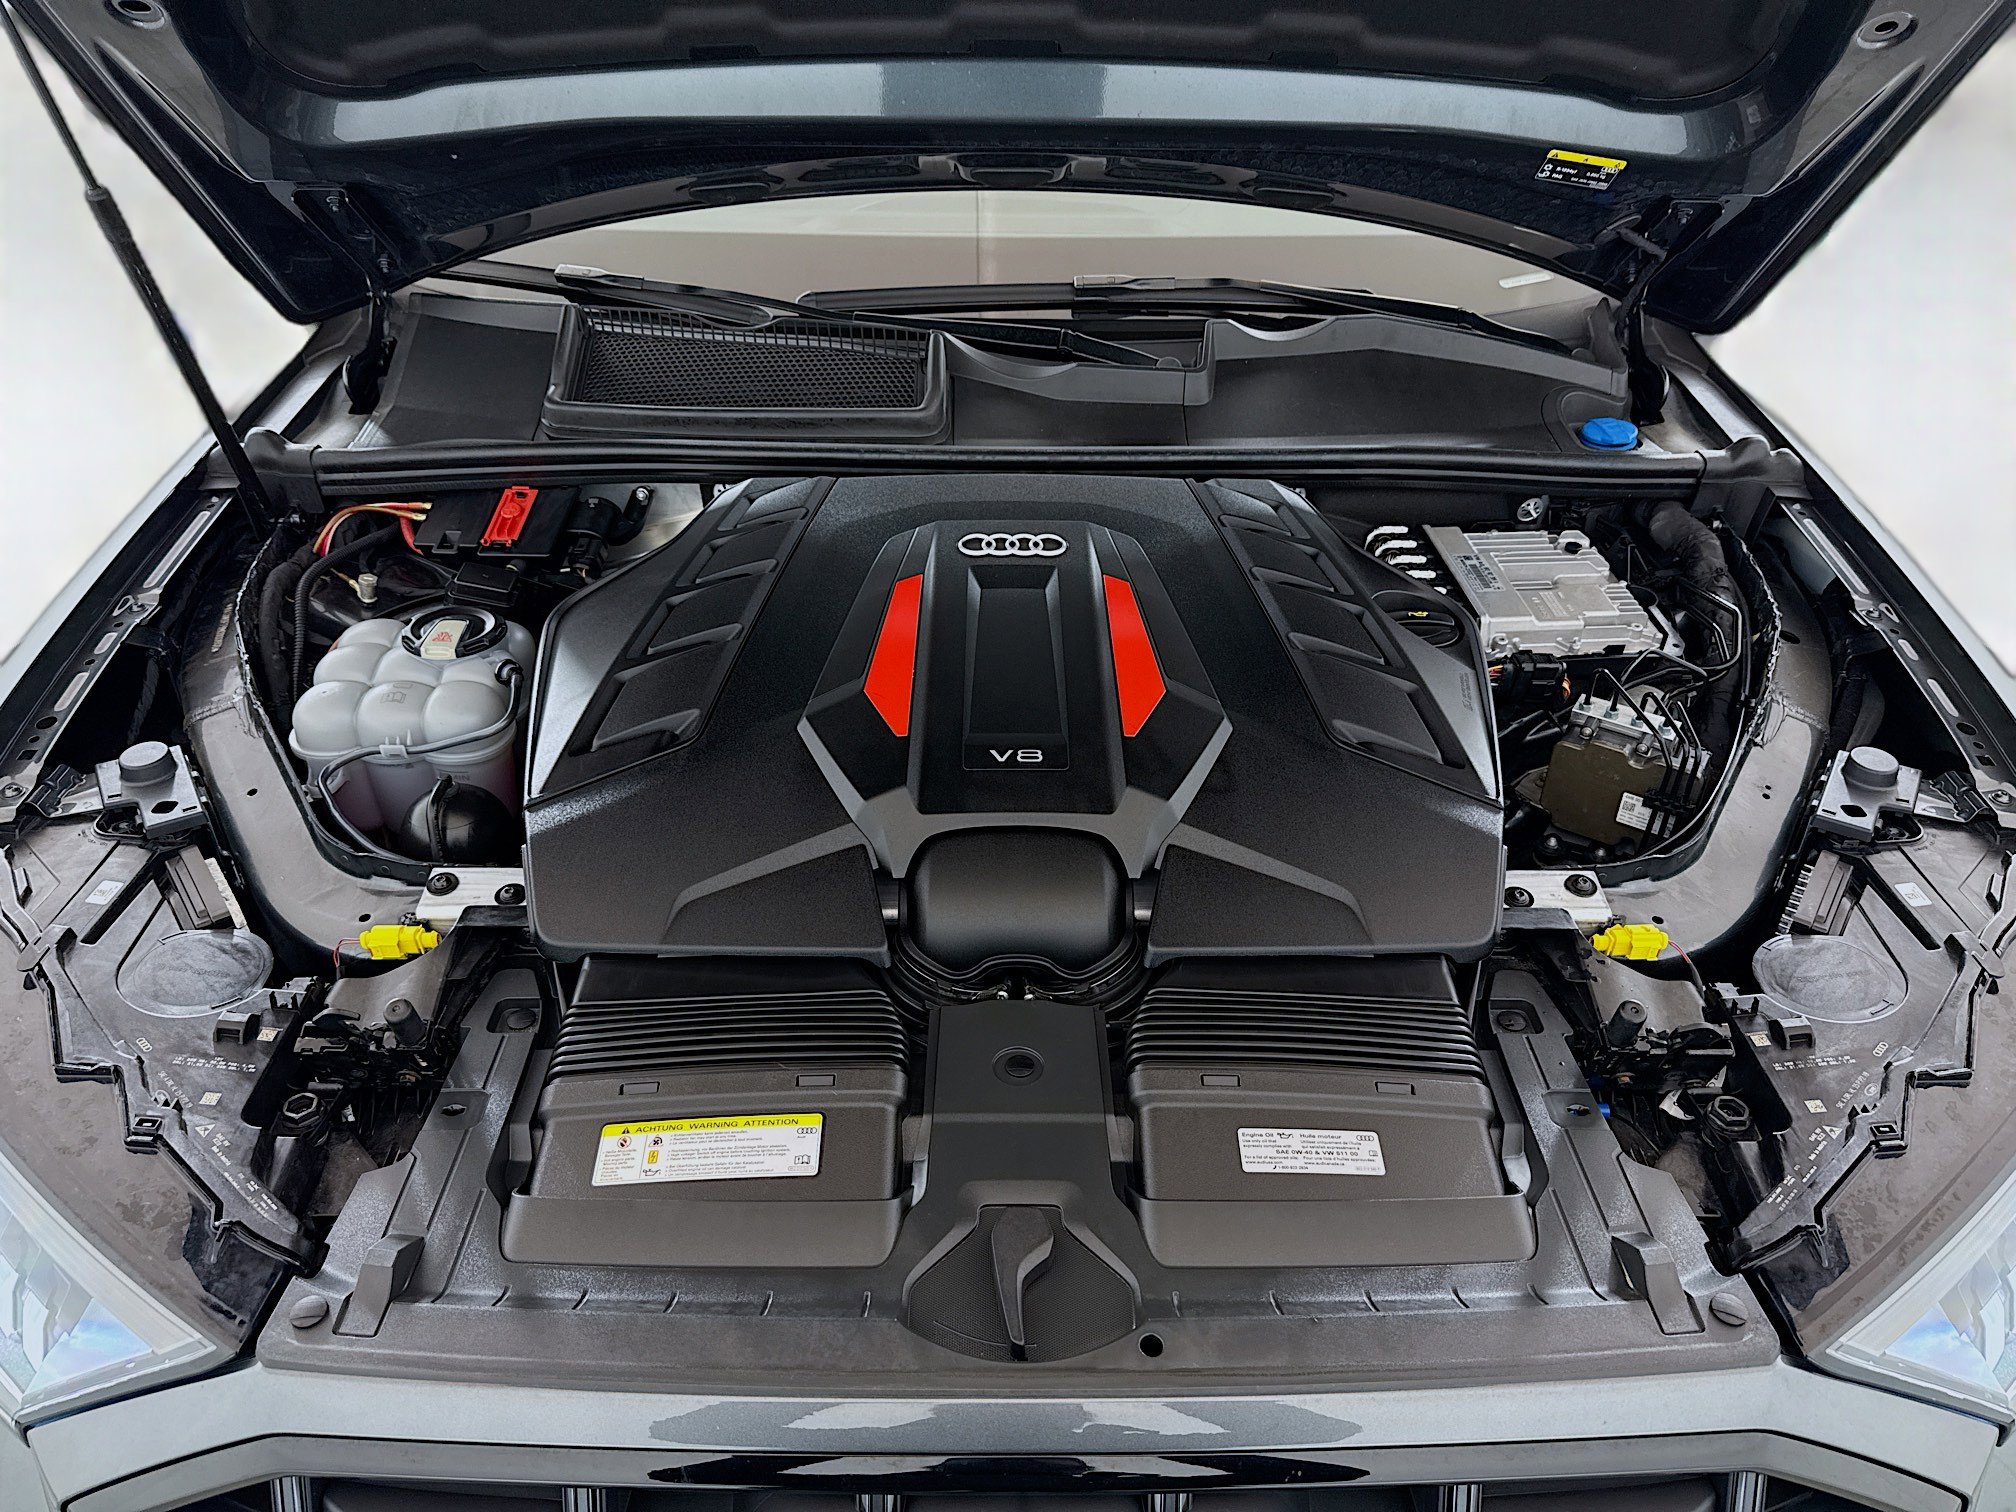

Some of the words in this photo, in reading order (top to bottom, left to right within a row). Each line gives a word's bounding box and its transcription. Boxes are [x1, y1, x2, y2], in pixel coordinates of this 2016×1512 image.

[989, 749, 1043, 762] V8
[635, 1123, 683, 1133] ACHTUNG
[689, 1120, 738, 1130] WARNING
[743, 1118, 799, 1127] ATTENTION
